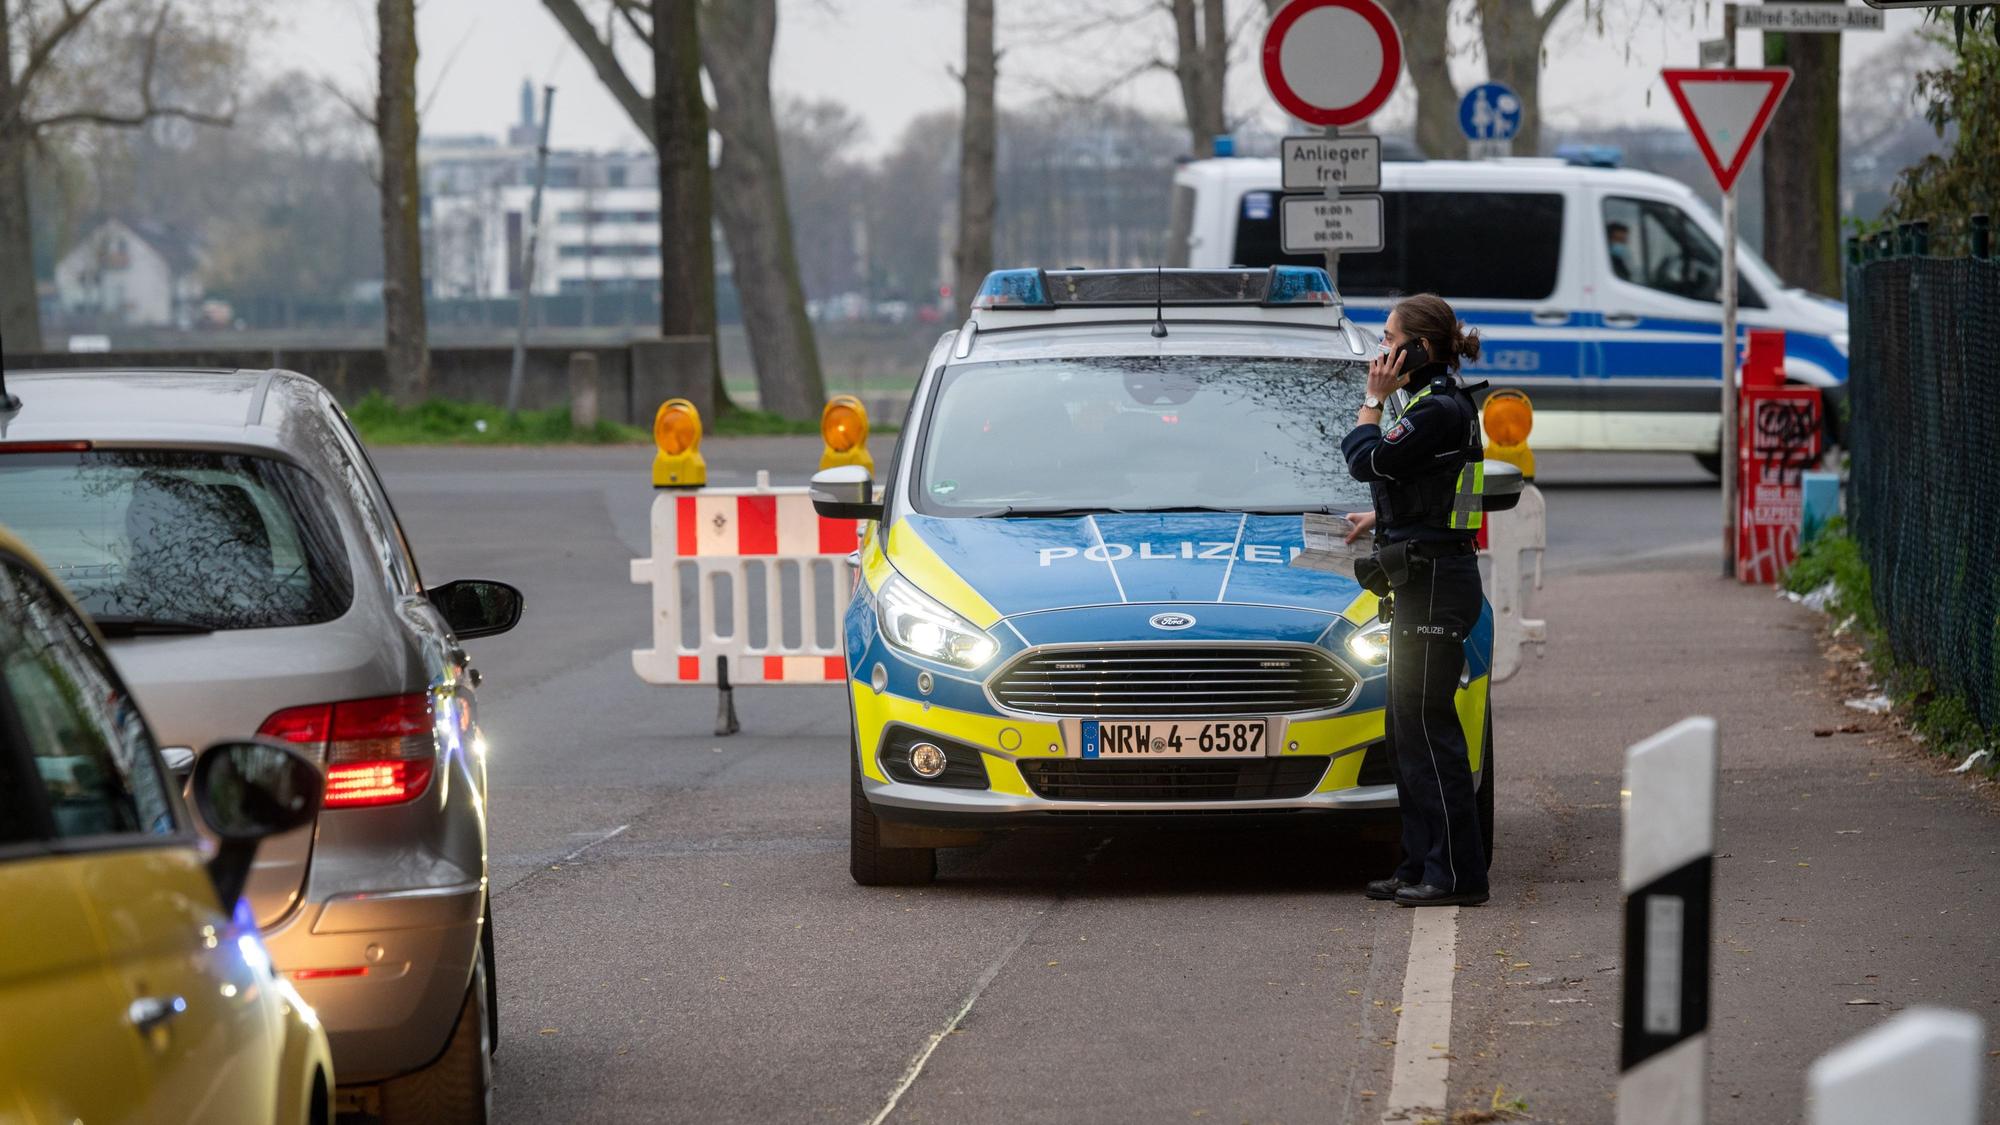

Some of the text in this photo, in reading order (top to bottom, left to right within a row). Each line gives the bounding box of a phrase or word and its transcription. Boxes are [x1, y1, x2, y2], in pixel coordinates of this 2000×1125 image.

[1294, 145, 1369, 164] Anlieger
[1317, 165, 1347, 181] frei
[1315, 205, 1353, 216] 18:00 h
[1325, 219, 1342, 229] bis
[1346, 230, 1354, 241] h
[1161, 616, 1184, 625] Ford
[1416, 626, 1444, 635] POLIZEI
[1100, 724, 1264, 753] NRW 4-6587
[1087, 743, 1094, 752] D
